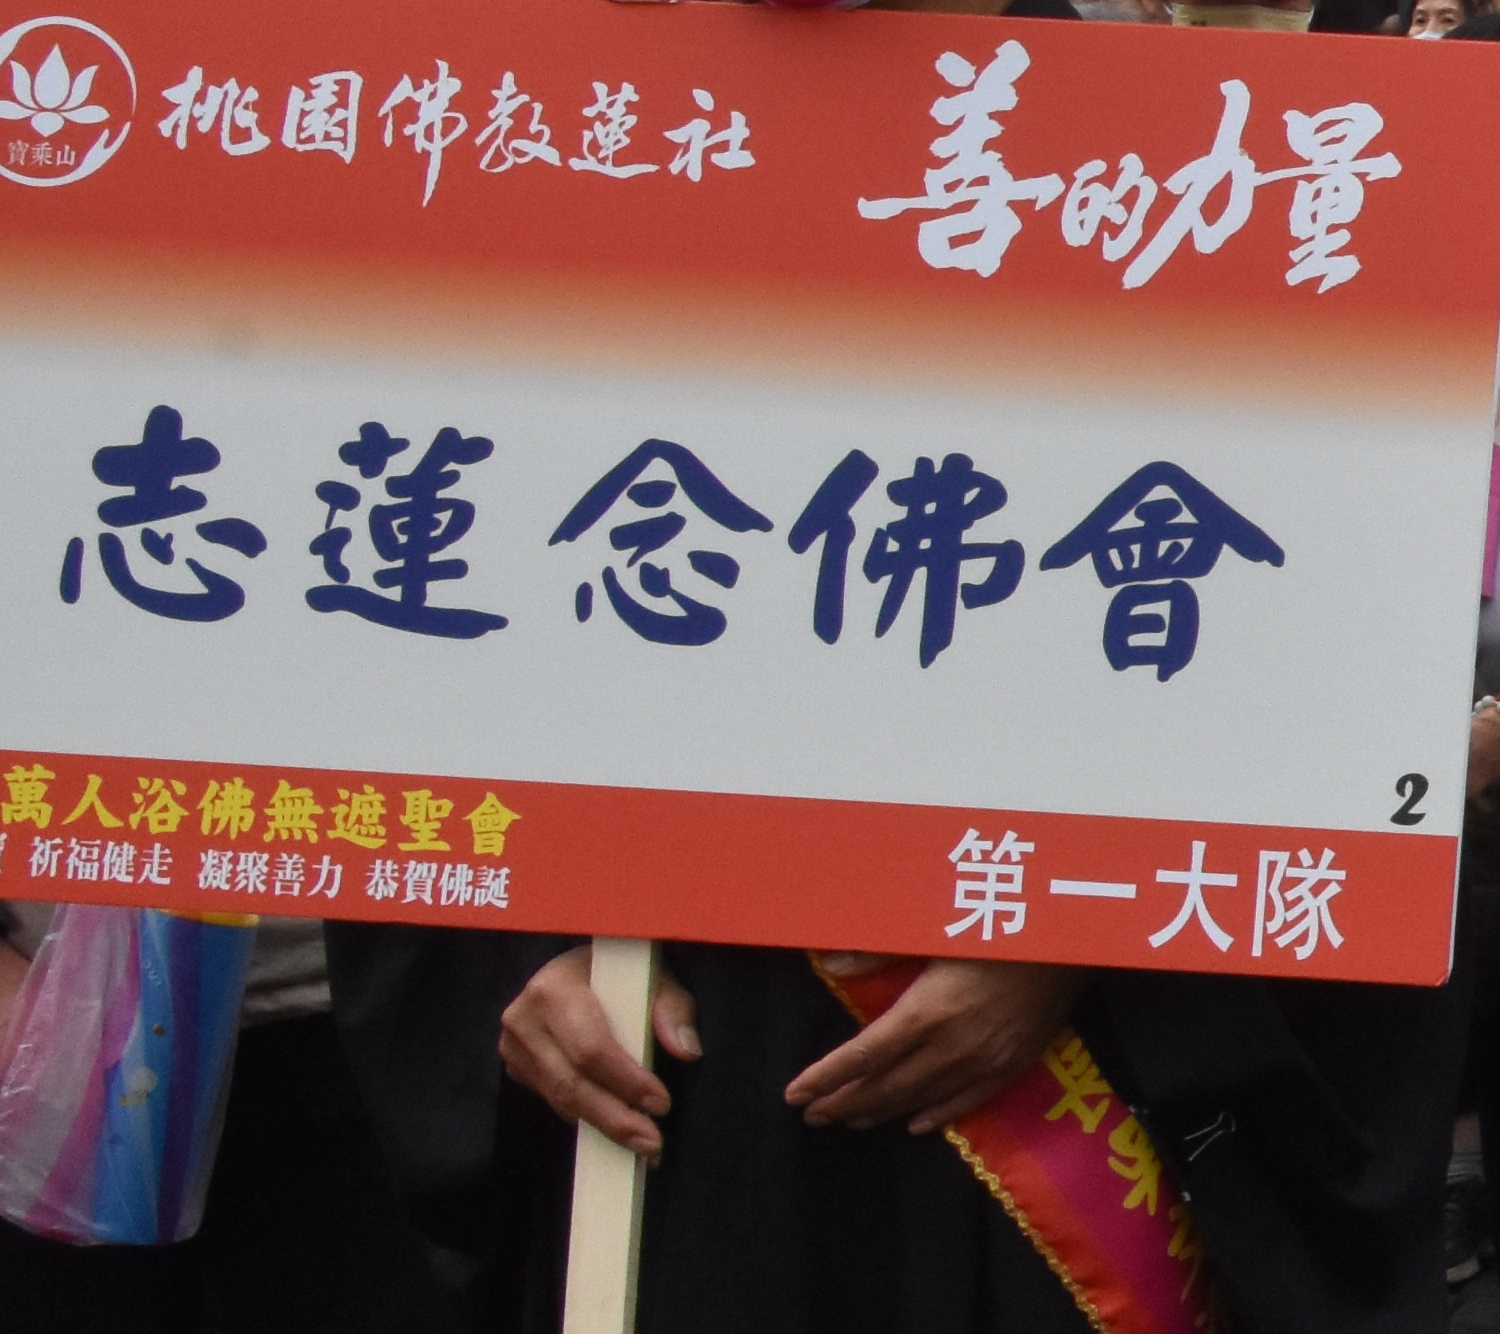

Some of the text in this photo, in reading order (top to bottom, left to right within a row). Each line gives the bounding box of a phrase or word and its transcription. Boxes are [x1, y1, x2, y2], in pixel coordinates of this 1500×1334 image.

[7, 138, 77, 170] 寶乘山
[157, 39, 1402, 295] 桃園佛教蓮社 善的力量
[60, 404, 1286, 683] 志蓮念佛會
[0, 764, 524, 857] 萬人浴佛無遮聖會
[1391, 772, 1429, 827] 2
[28, 835, 512, 910] 祈福健走 凝聚善力 恭賀佛誕
[943, 829, 1351, 966] 第一大隊
